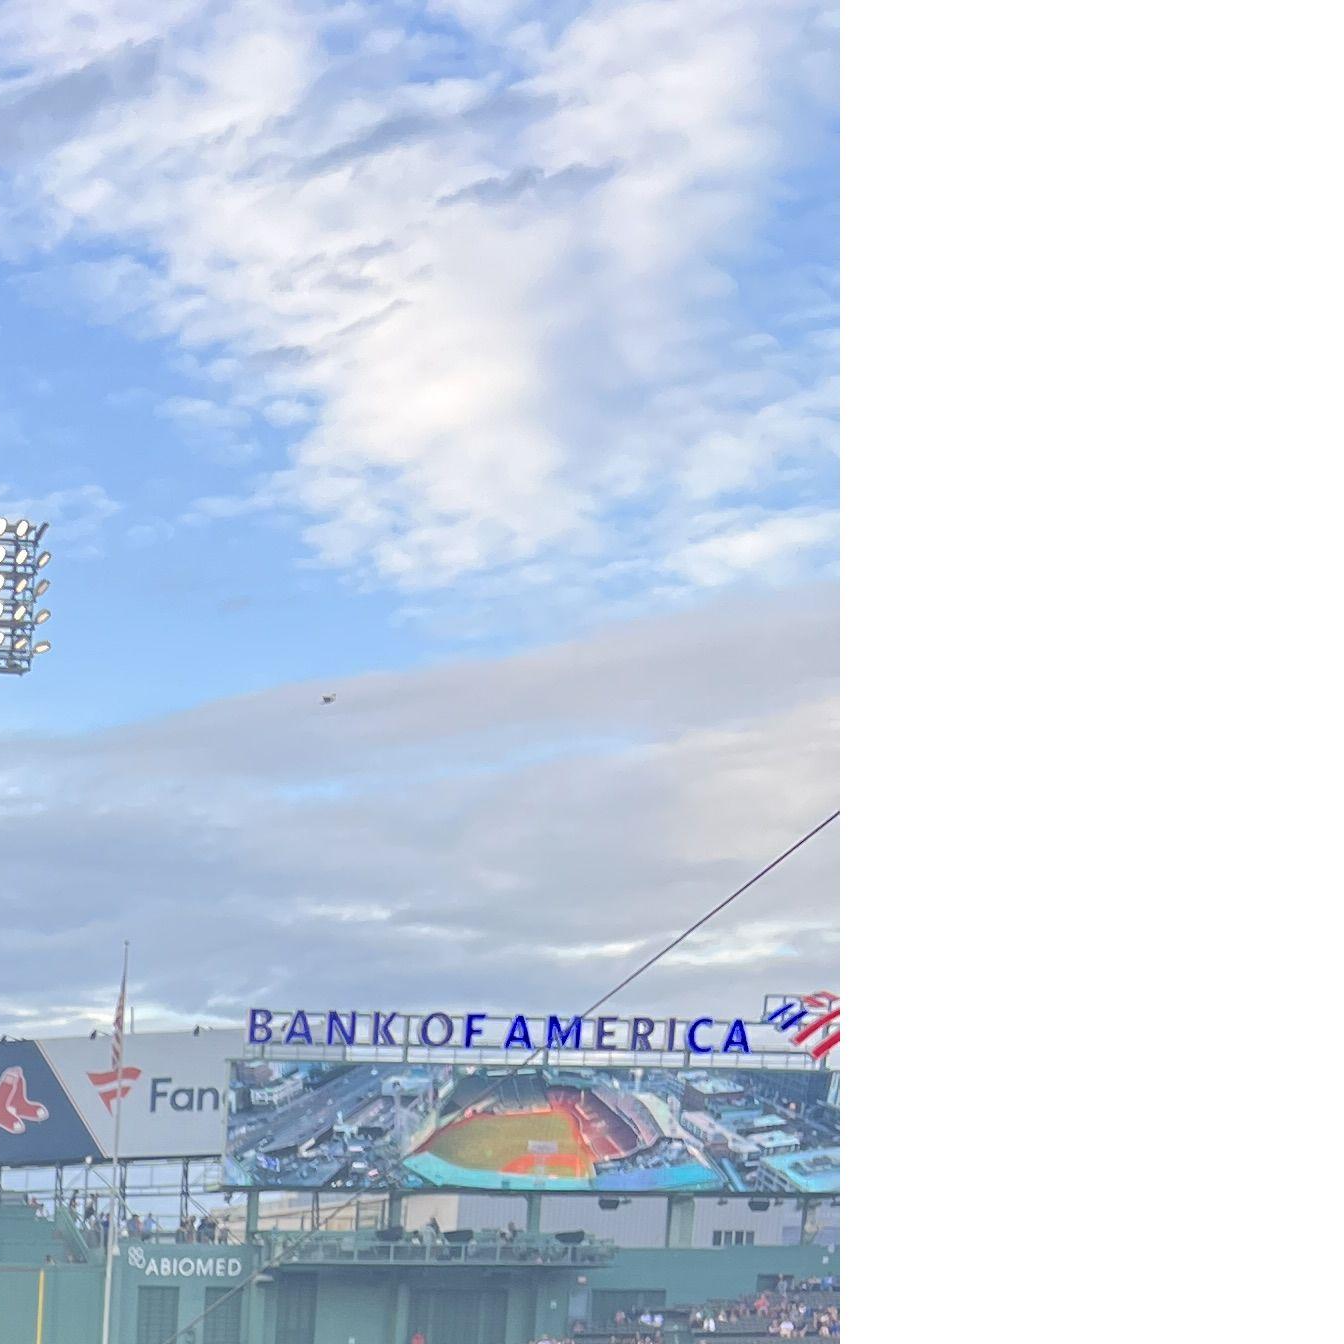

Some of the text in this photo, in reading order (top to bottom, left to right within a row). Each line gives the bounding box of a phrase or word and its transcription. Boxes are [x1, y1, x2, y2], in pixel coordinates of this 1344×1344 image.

[247, 1008, 751, 1054] BANK OF AMERICA
[149, 1078, 226, 1113] Fan
[144, 1256, 242, 1278] ABIOMED
